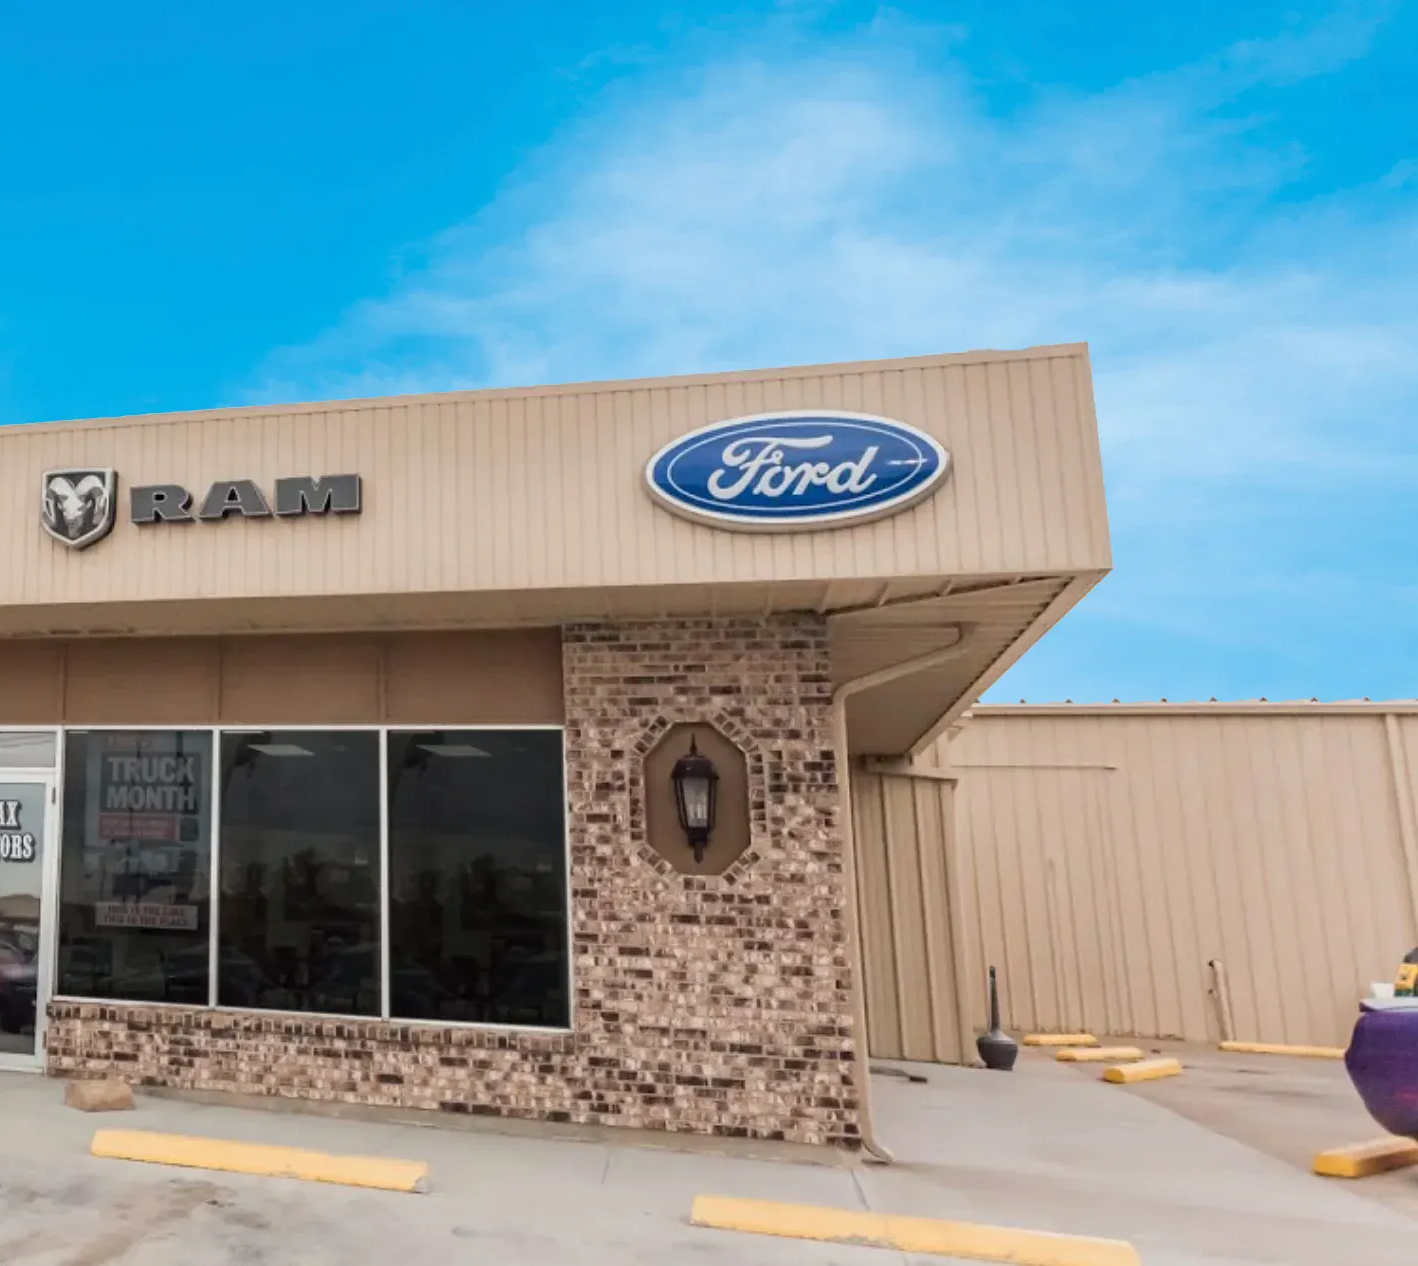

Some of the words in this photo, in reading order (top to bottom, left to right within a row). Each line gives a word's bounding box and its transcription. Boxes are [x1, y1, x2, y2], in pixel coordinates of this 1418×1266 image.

[706, 435, 880, 500] Ford
[129, 473, 363, 525] RAM
[107, 755, 195, 784] TRUCK
[106, 784, 195, 811] MONTH
